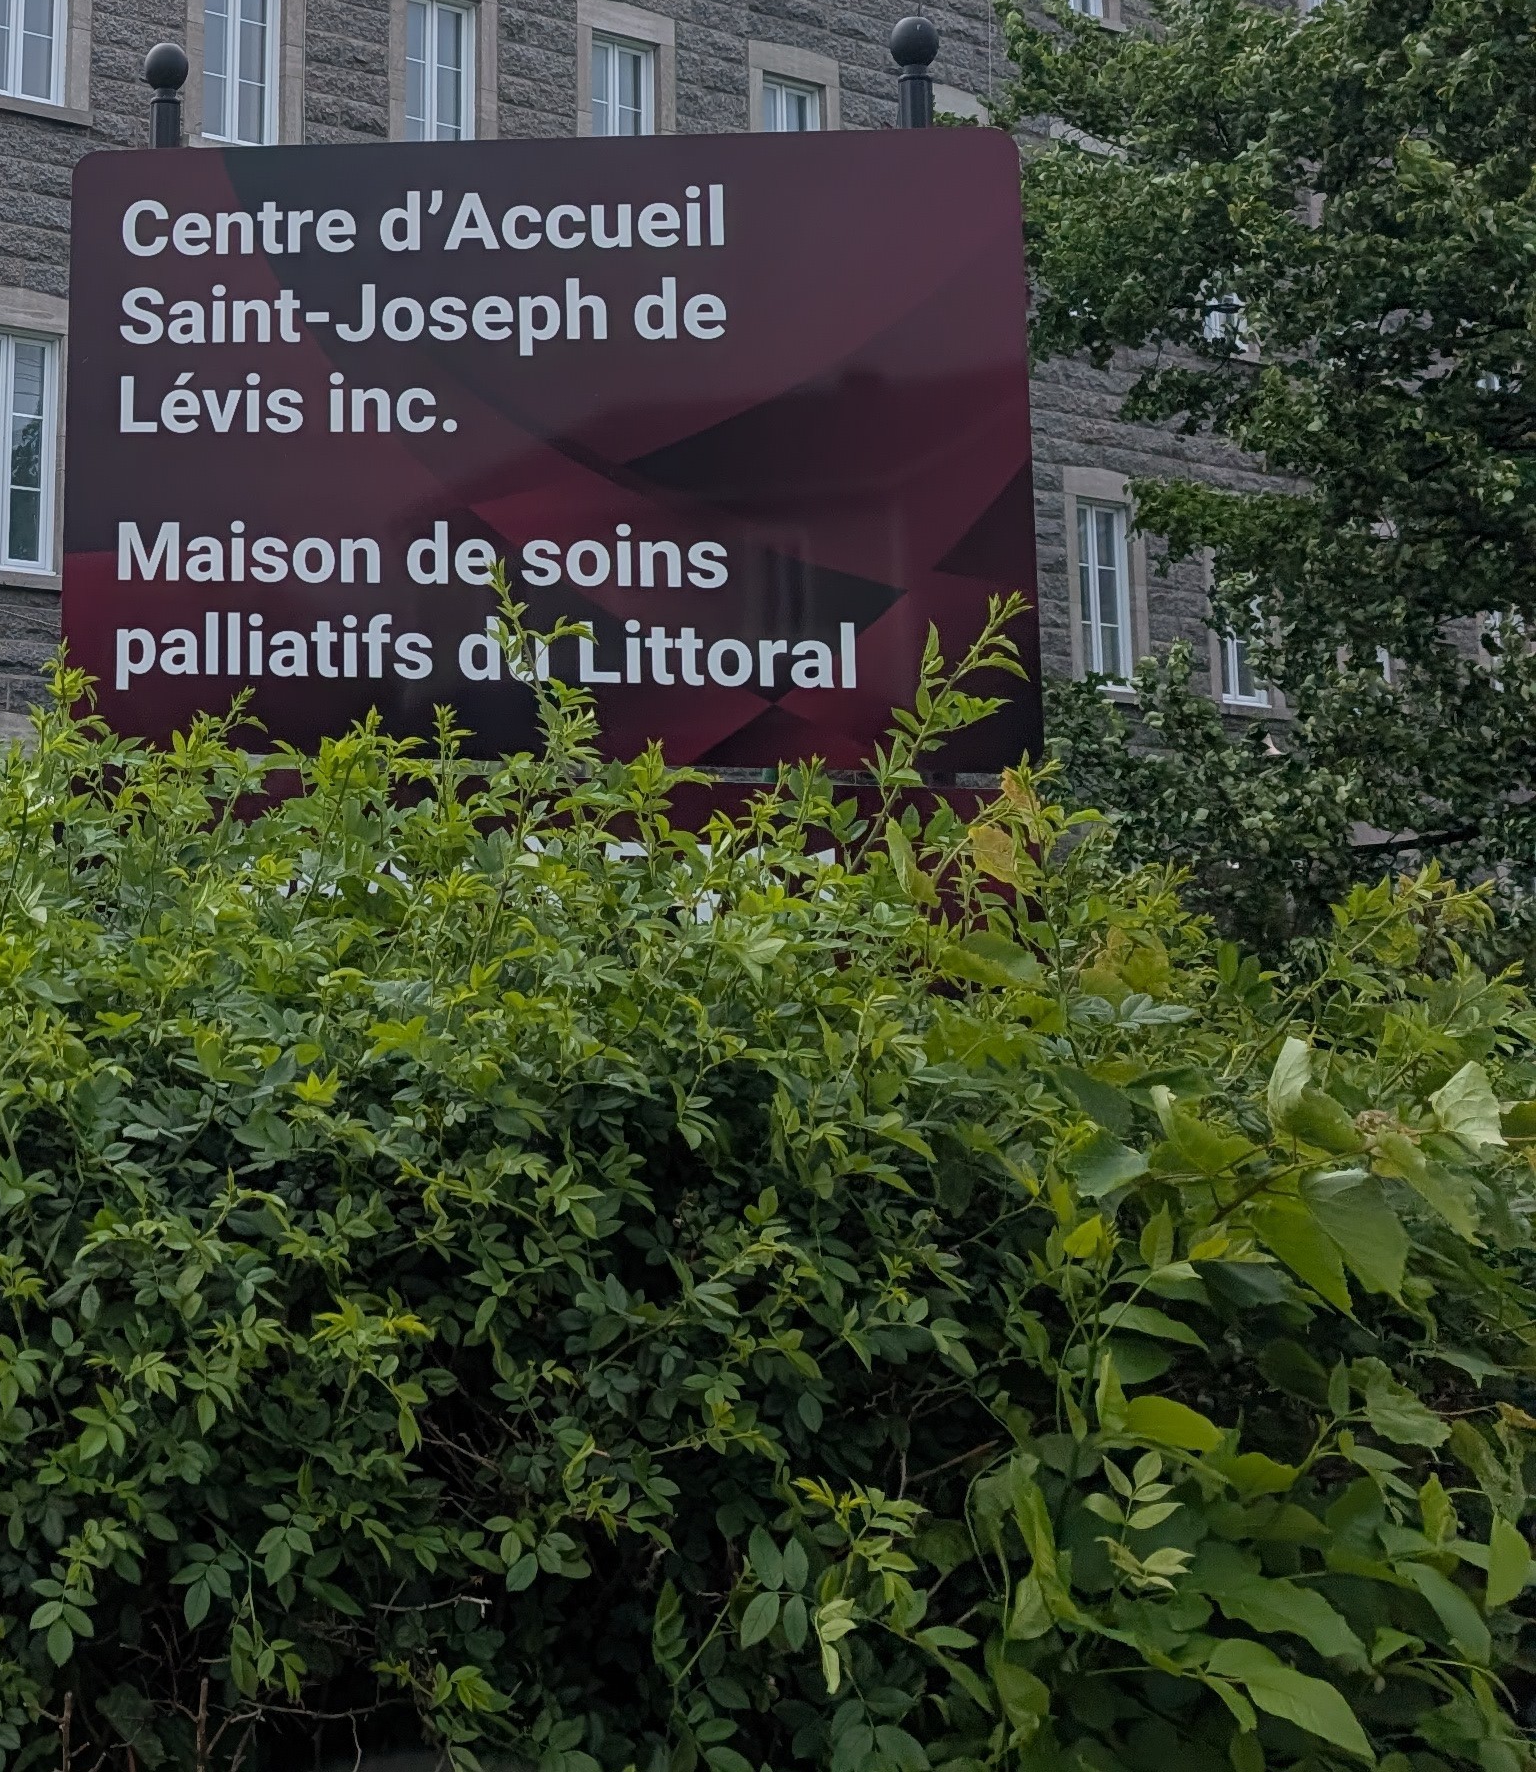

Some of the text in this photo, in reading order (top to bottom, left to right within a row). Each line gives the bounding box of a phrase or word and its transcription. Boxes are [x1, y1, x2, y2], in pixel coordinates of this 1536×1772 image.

[122, 199, 357, 257] Centre
[119, 276, 728, 357] Saint-Joseph de
[119, 371, 458, 434] Lévis inc.
[117, 520, 729, 589] Maison de soins
[115, 611, 433, 691] palliatifs
[578, 620, 858, 689] Littoral
